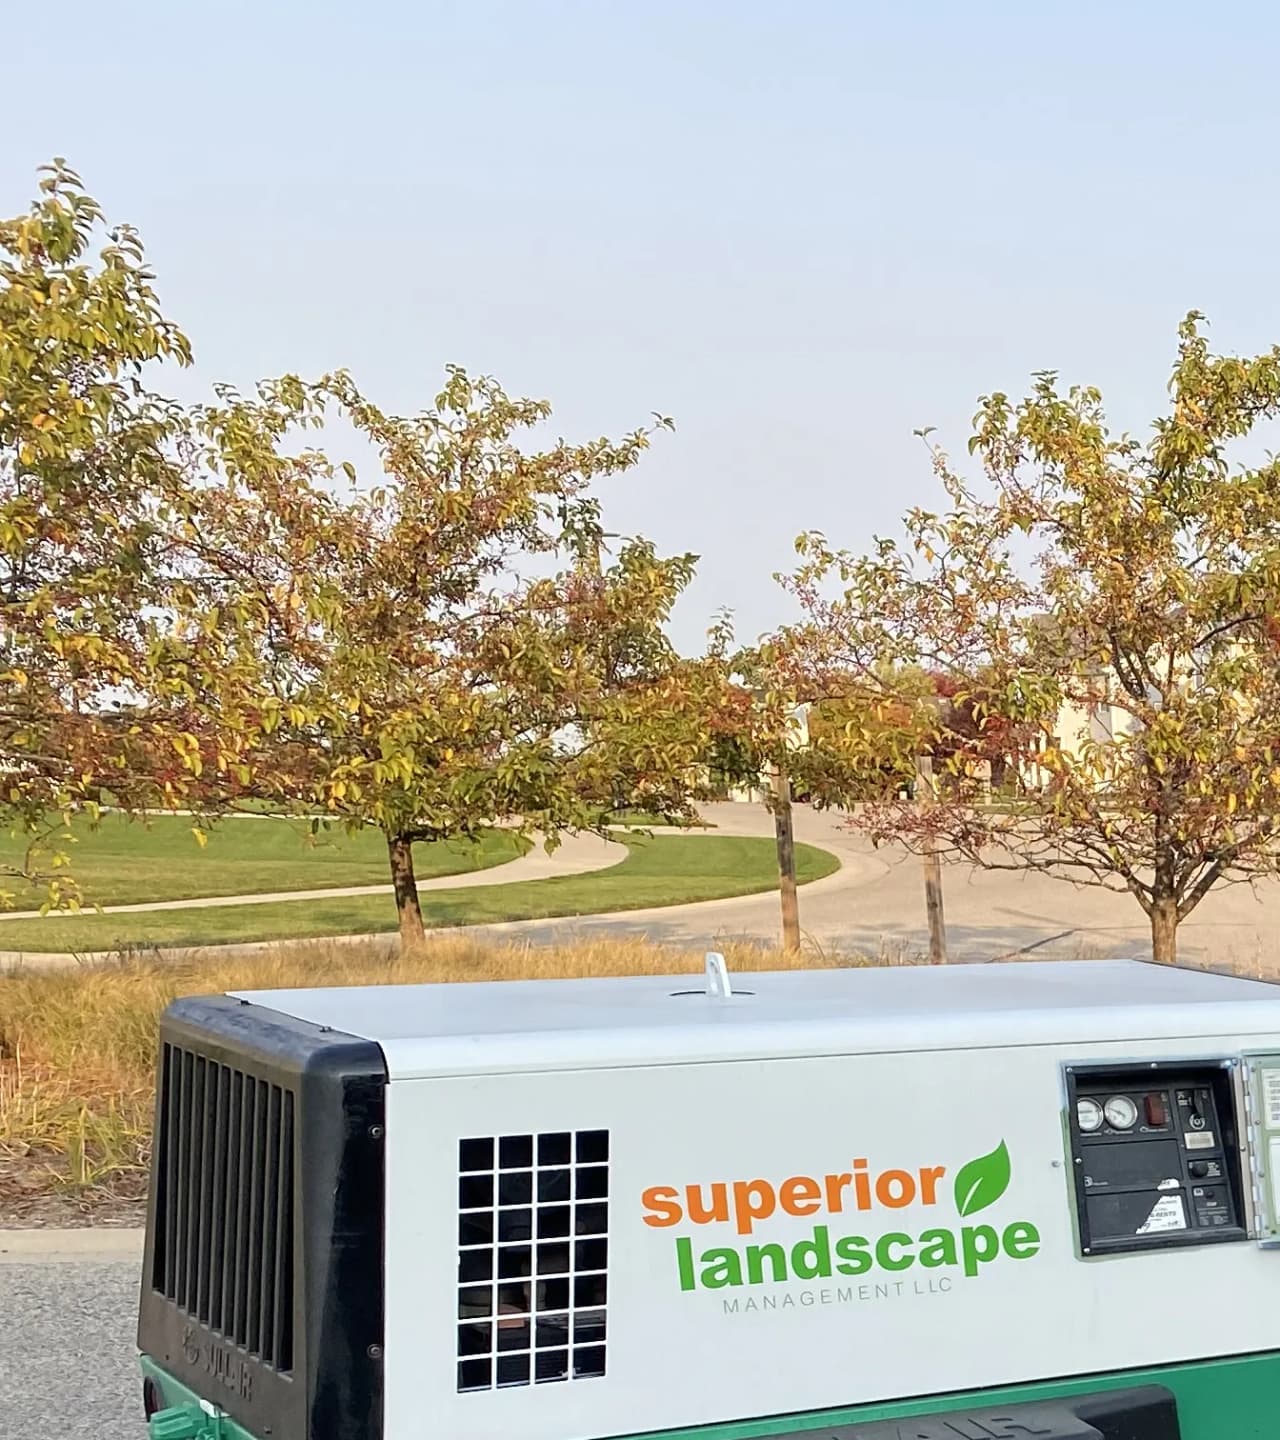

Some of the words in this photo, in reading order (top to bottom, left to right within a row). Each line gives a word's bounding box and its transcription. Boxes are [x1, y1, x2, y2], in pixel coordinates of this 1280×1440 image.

[641, 1158, 947, 1235] superior
[675, 1221, 1041, 1292] landscape
[722, 1281, 905, 1315] MANAGEMENT
[914, 1276, 953, 1297] LLC
